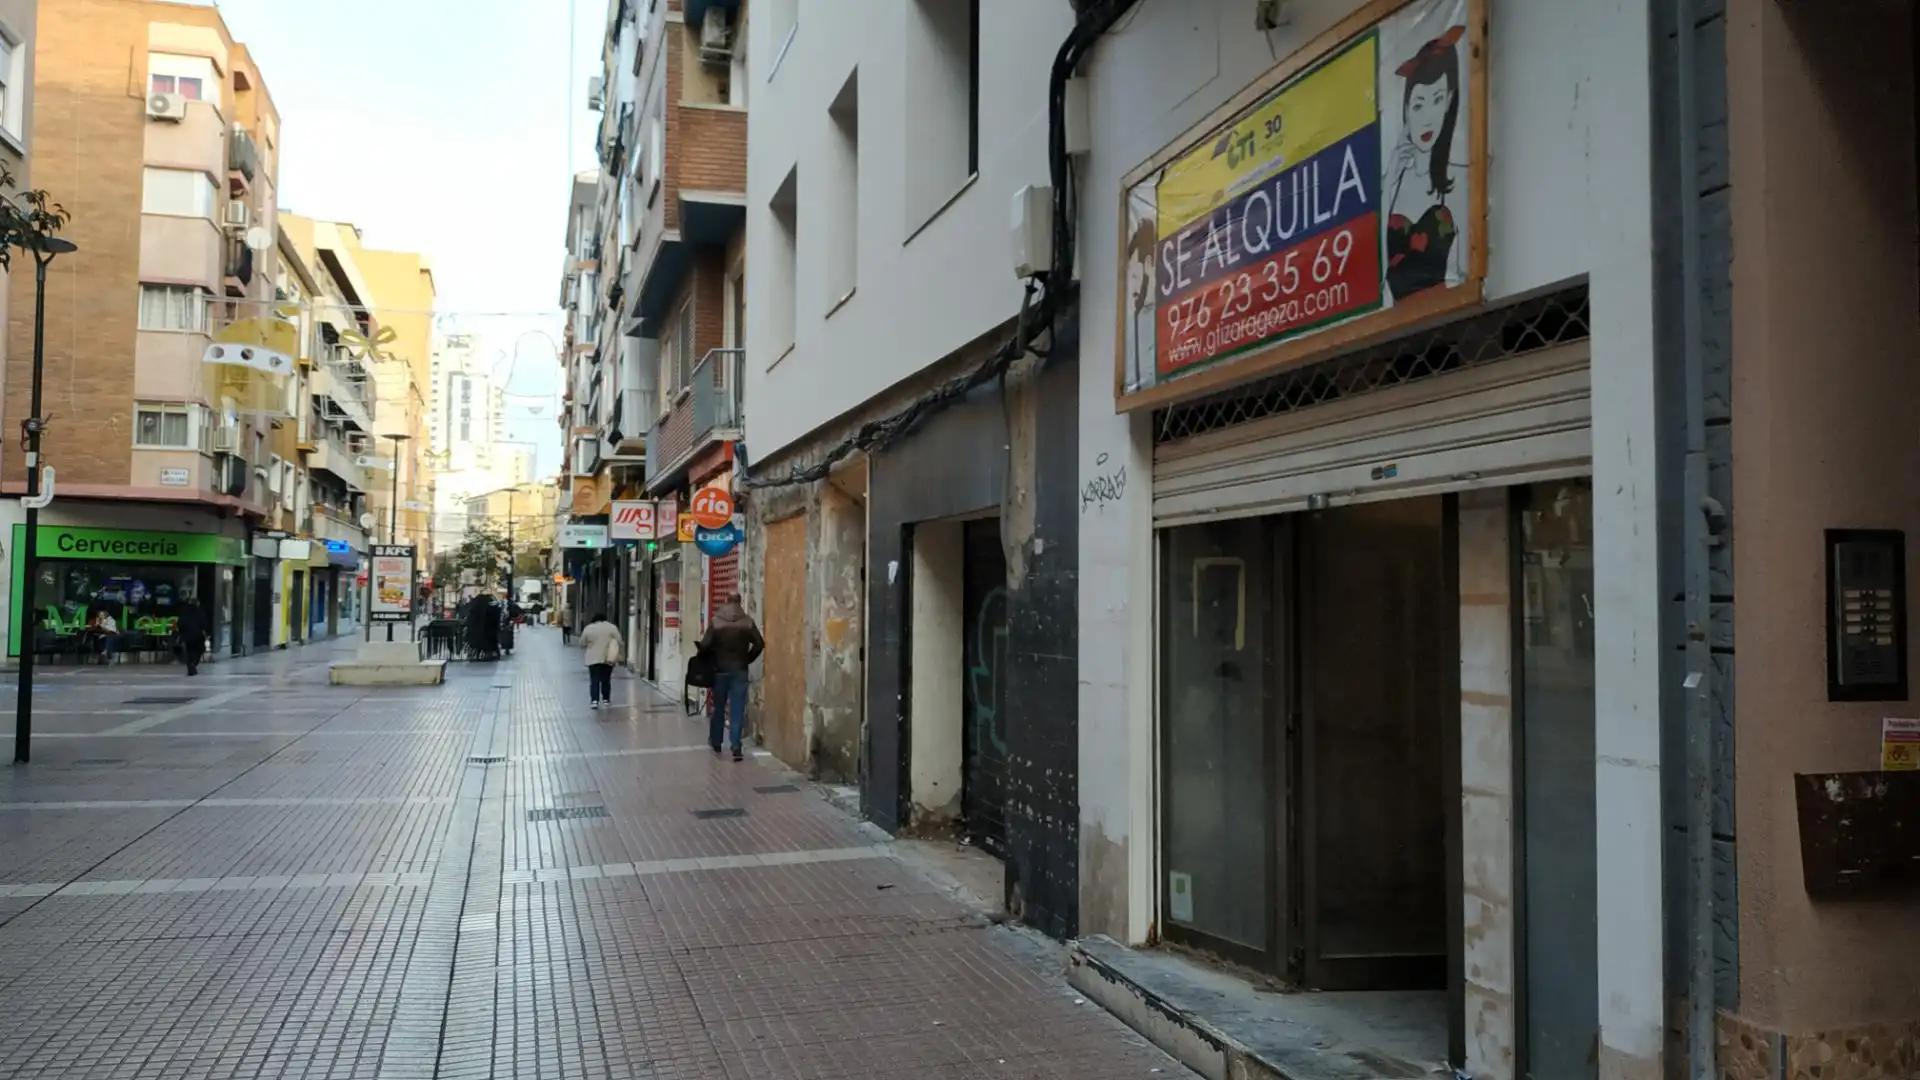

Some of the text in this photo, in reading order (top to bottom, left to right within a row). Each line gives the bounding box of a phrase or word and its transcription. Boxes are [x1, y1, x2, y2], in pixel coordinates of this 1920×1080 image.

[1265, 114, 1282, 139] 30
[1161, 230, 1191, 296] SE
[1200, 144, 1367, 278] ALQUILA
[1167, 230, 1353, 341] 976 23 35 69
[1169, 281, 1349, 363] www.gtizaragoza.com
[696, 491, 729, 515] ria
[57, 533, 178, 556] Cervecería
[385, 546, 411, 556] KFC
